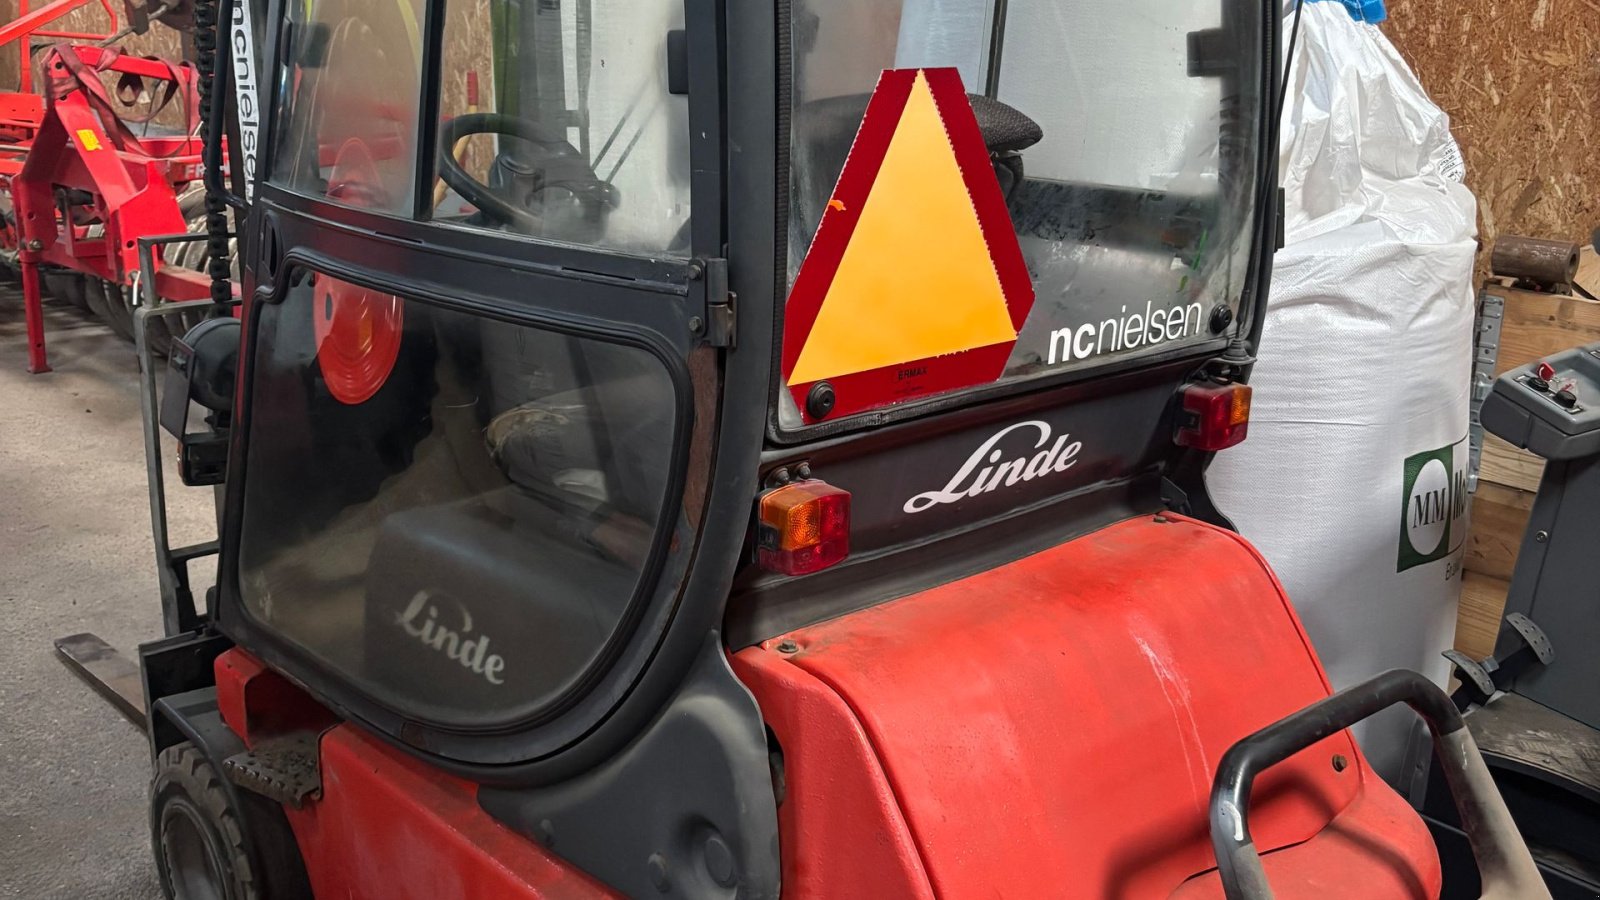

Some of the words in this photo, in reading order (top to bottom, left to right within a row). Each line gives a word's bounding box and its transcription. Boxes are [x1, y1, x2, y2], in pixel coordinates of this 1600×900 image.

[1047, 300, 1202, 365] ncnielsen
[903, 420, 1081, 513] Linde
[1413, 489, 1446, 528] MM
[394, 589, 505, 684] Linde
